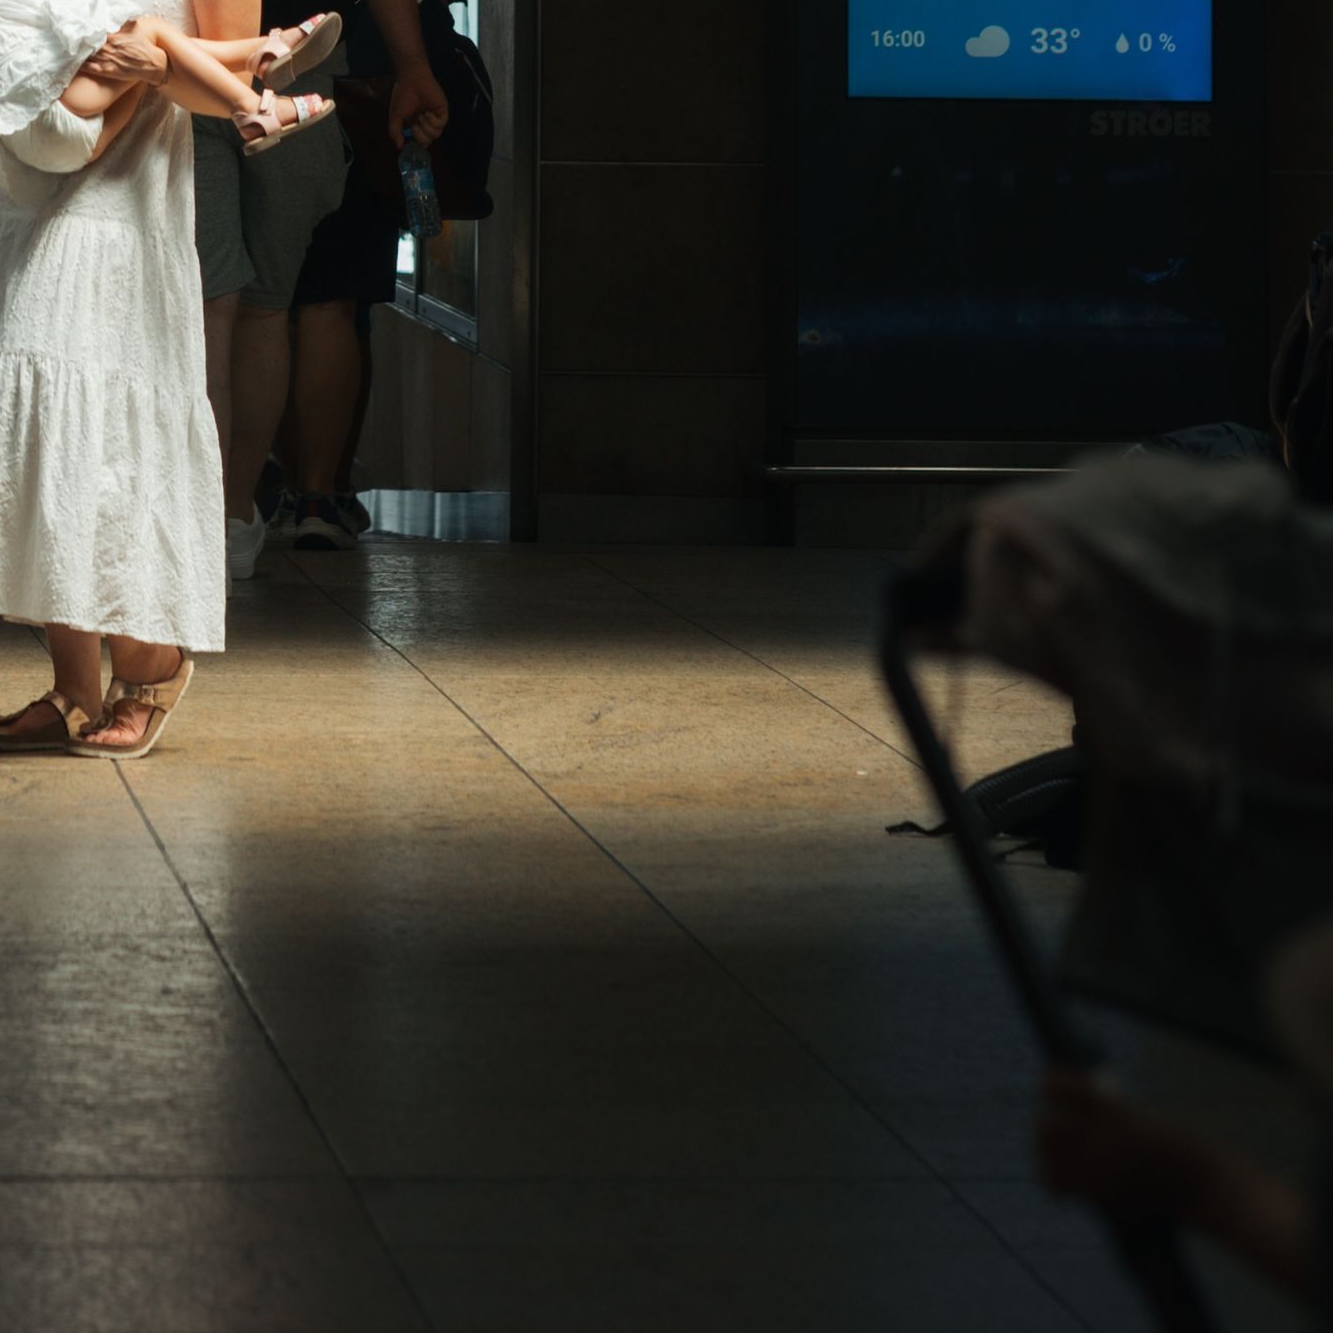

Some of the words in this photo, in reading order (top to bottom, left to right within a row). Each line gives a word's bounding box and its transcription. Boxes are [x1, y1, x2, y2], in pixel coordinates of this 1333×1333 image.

[870, 30, 925, 48] 16:00
[1030, 28, 1081, 55] 33°
[1138, 33, 1151, 52] 0
[1158, 33, 1177, 53] %
